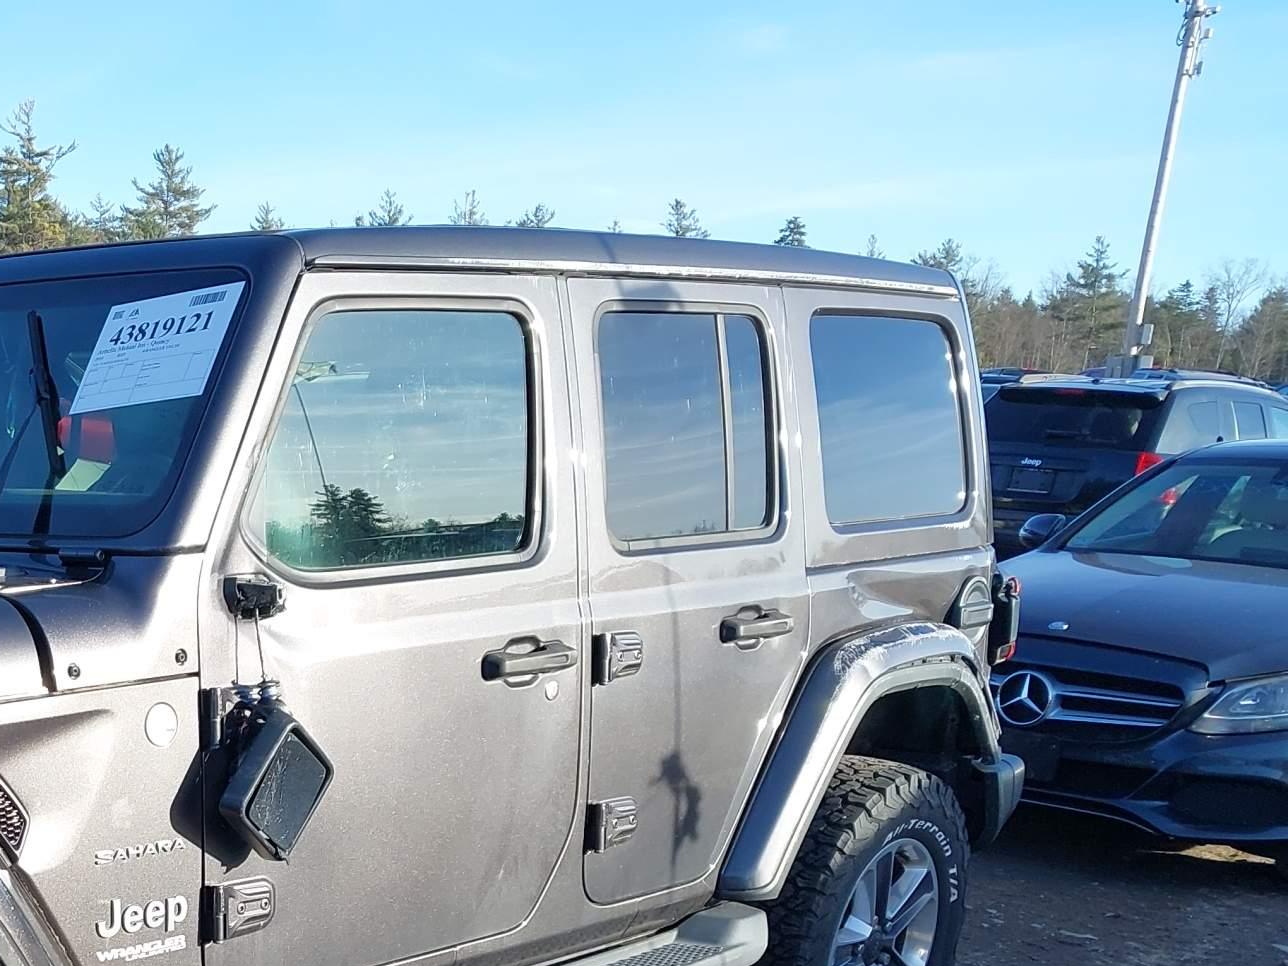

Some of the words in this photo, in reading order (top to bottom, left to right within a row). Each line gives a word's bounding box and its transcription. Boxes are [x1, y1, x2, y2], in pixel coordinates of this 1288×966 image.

[109, 310, 214, 346] 43819121
[1021, 457, 1042, 467] Jeep
[94, 837, 187, 866] SAHARA
[881, 818, 952, 857] All-Terrain
[948, 864, 959, 903] T/A
[95, 894, 188, 939] Jeep
